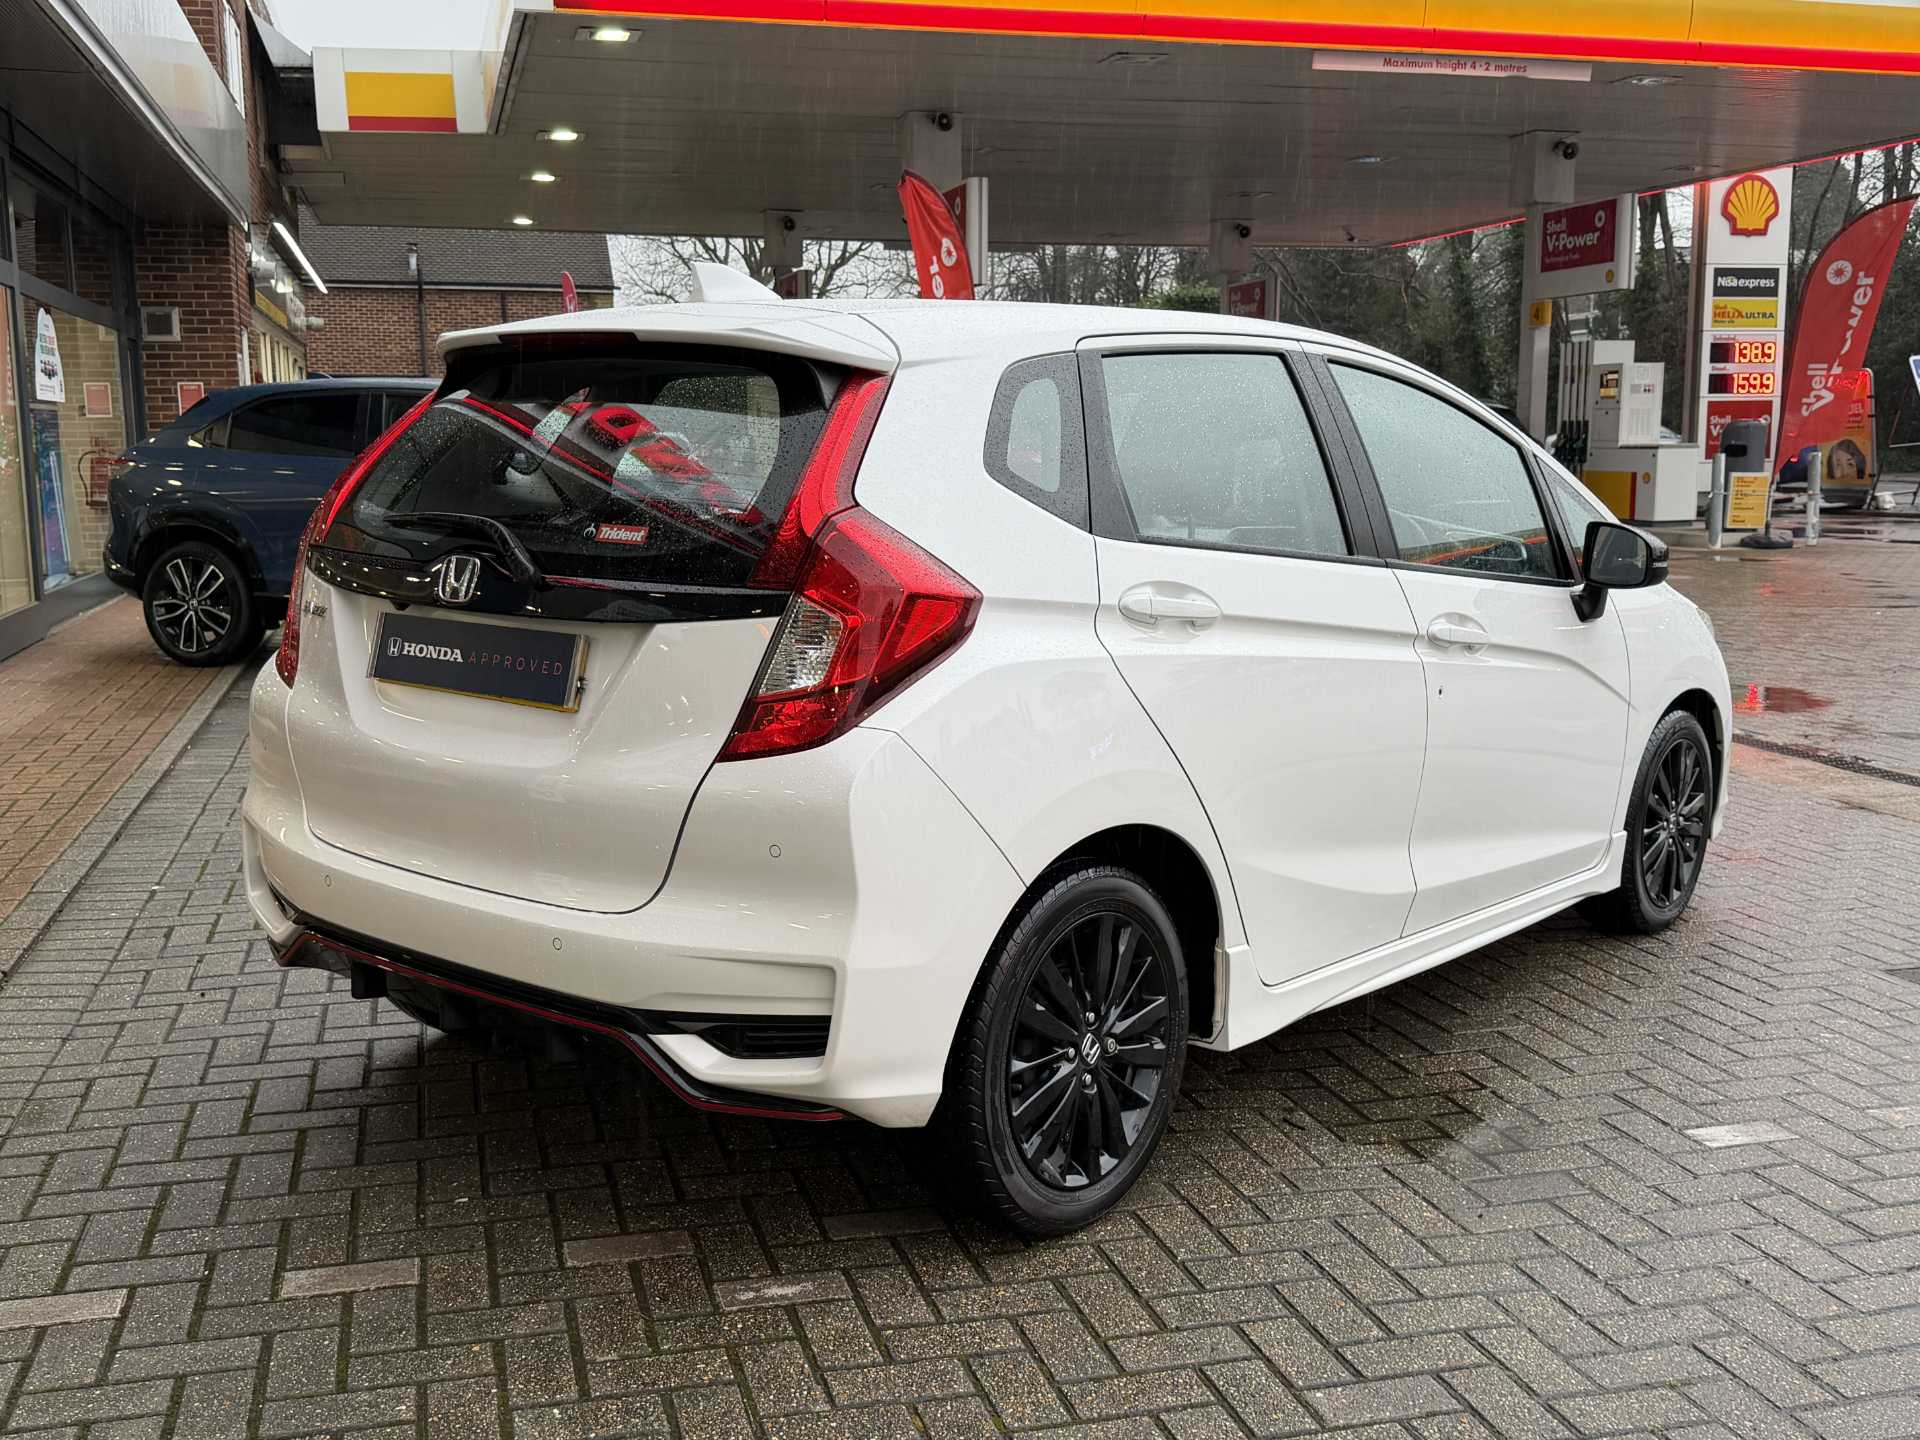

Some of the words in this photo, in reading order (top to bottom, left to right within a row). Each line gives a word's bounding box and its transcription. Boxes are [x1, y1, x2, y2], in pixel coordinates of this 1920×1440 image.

[1383, 57, 1433, 68] Maximum
[1436, 58, 1467, 72] height
[1494, 63, 1527, 73] metres
[1545, 217, 1567, 234] Shell
[1738, 278, 1775, 289] express
[1745, 311, 1775, 320] ULTRA
[1734, 342, 1776, 363] 138.9
[1733, 373, 1774, 394] 159.9
[600, 526, 645, 541] Trident
[401, 641, 464, 663] HONDA
[468, 651, 564, 676] APPROVED
